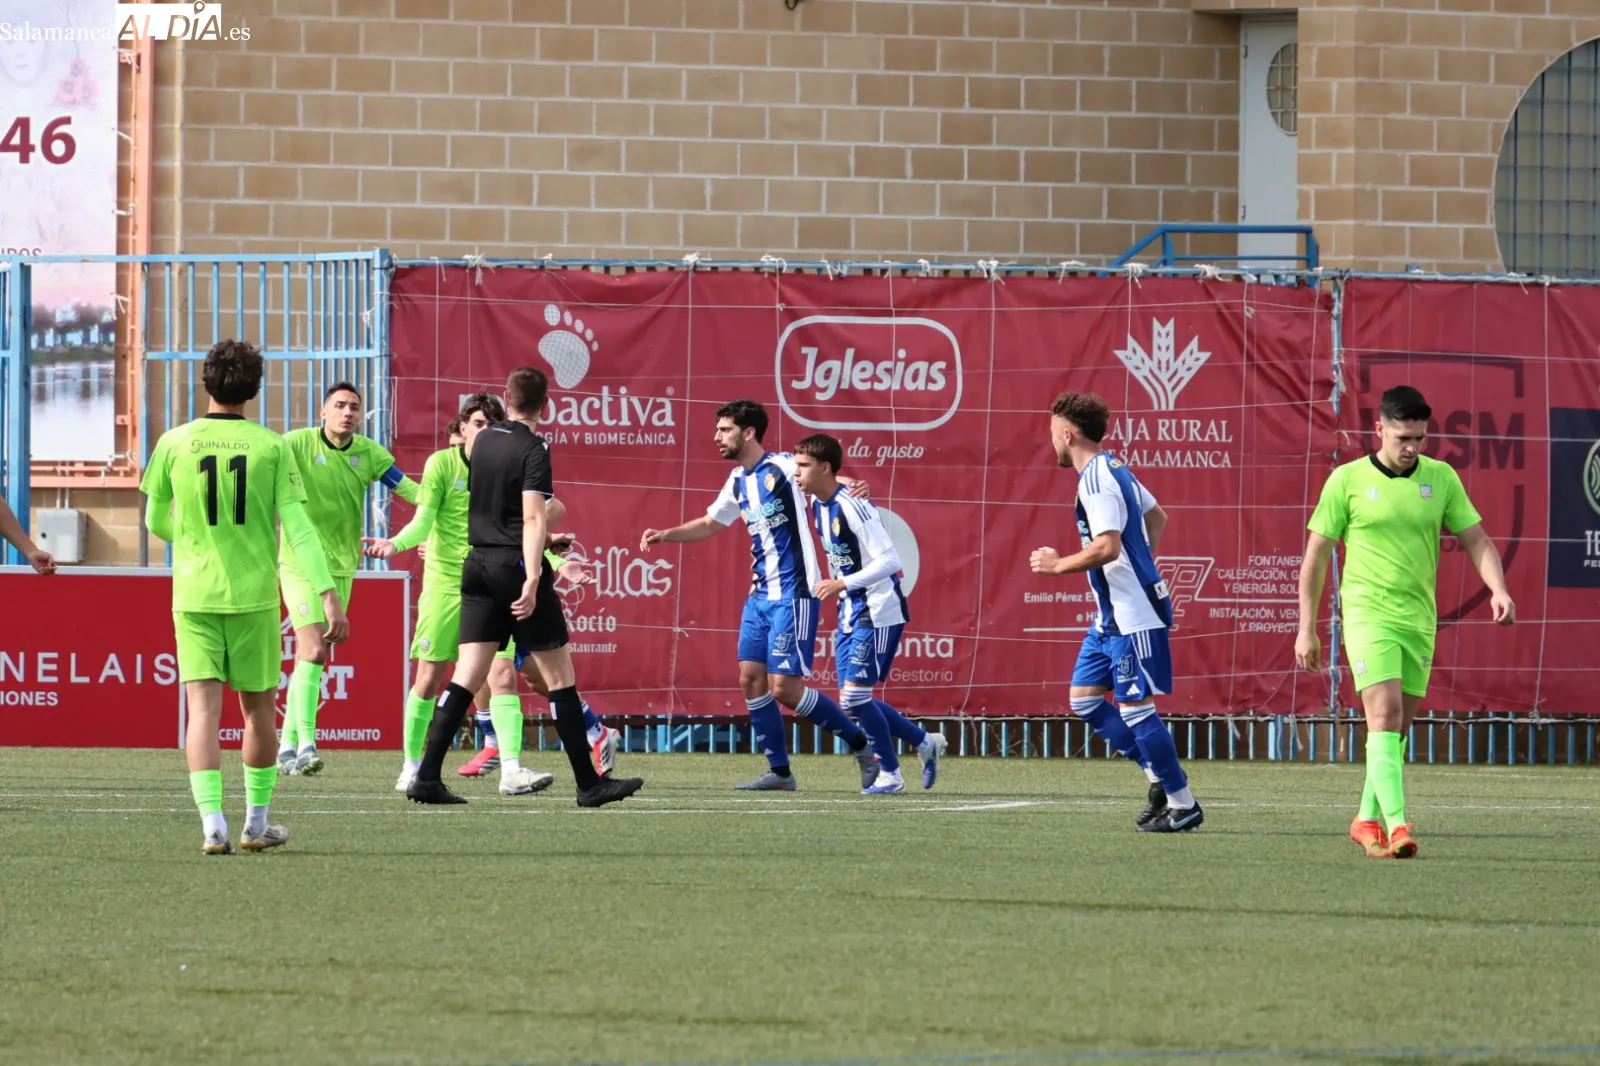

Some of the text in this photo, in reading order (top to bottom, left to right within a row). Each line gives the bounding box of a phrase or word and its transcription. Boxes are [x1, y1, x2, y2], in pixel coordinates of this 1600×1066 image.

[0, 116, 77, 165] 46
[573, 432, 580, 444] Y
[585, 428, 676, 445] BIOMECÁNICA
[1101, 417, 1233, 446] AJA RURAL
[847, 437, 924, 467] da gusto
[1120, 449, 1232, 469] SALAMANCA
[197, 455, 247, 526] 11
[1248, 555, 1302, 566] FONTANER
[1218, 567, 1289, 581] CALEFACCIÓN,
[1223, 581, 1299, 594] Y ENERGÍA SOL
[1024, 592, 1053, 603] Emilio
[1055, 592, 1083, 602] Pérez
[1209, 606, 1299, 619] INSTALACIÓN, VEN
[1240, 622, 1299, 633] Y PROYECT
[0, 651, 177, 685] NELAIS
[889, 667, 954, 682] Gestoría
